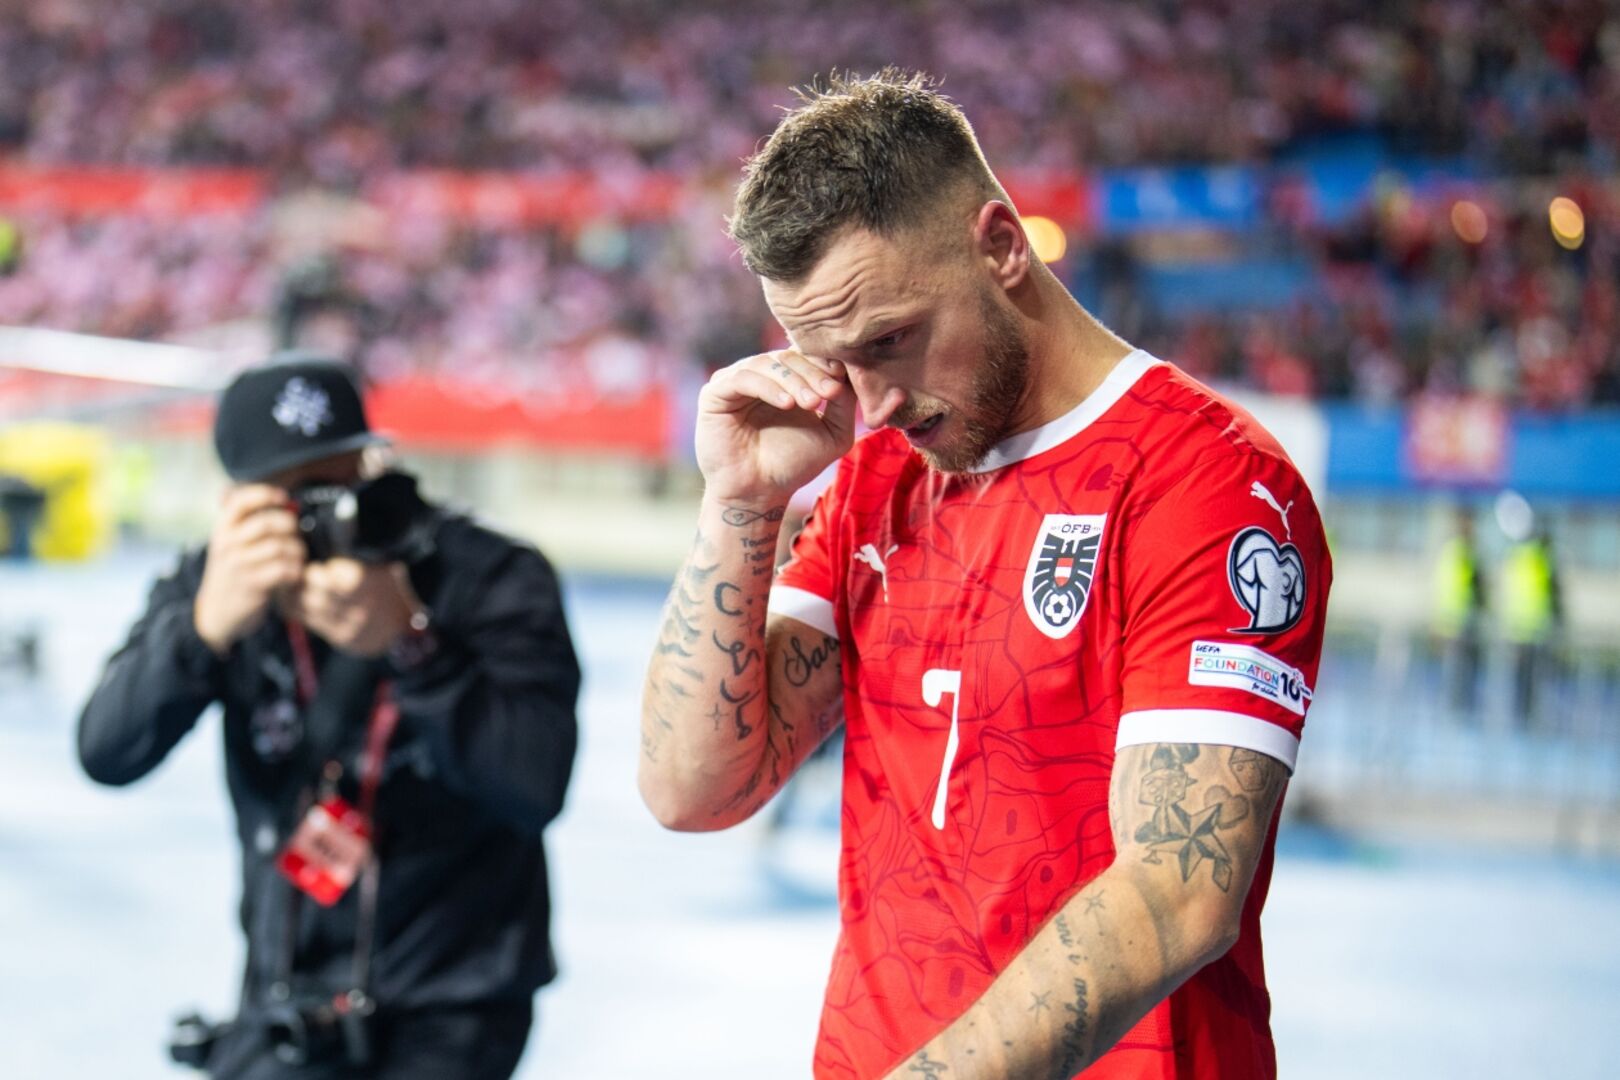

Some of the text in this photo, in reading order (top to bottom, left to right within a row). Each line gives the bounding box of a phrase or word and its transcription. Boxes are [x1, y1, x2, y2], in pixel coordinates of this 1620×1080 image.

[1195, 645, 1221, 653] UEFA
[1194, 658, 1279, 686] FOUNDATION
[922, 668, 962, 830] 7
